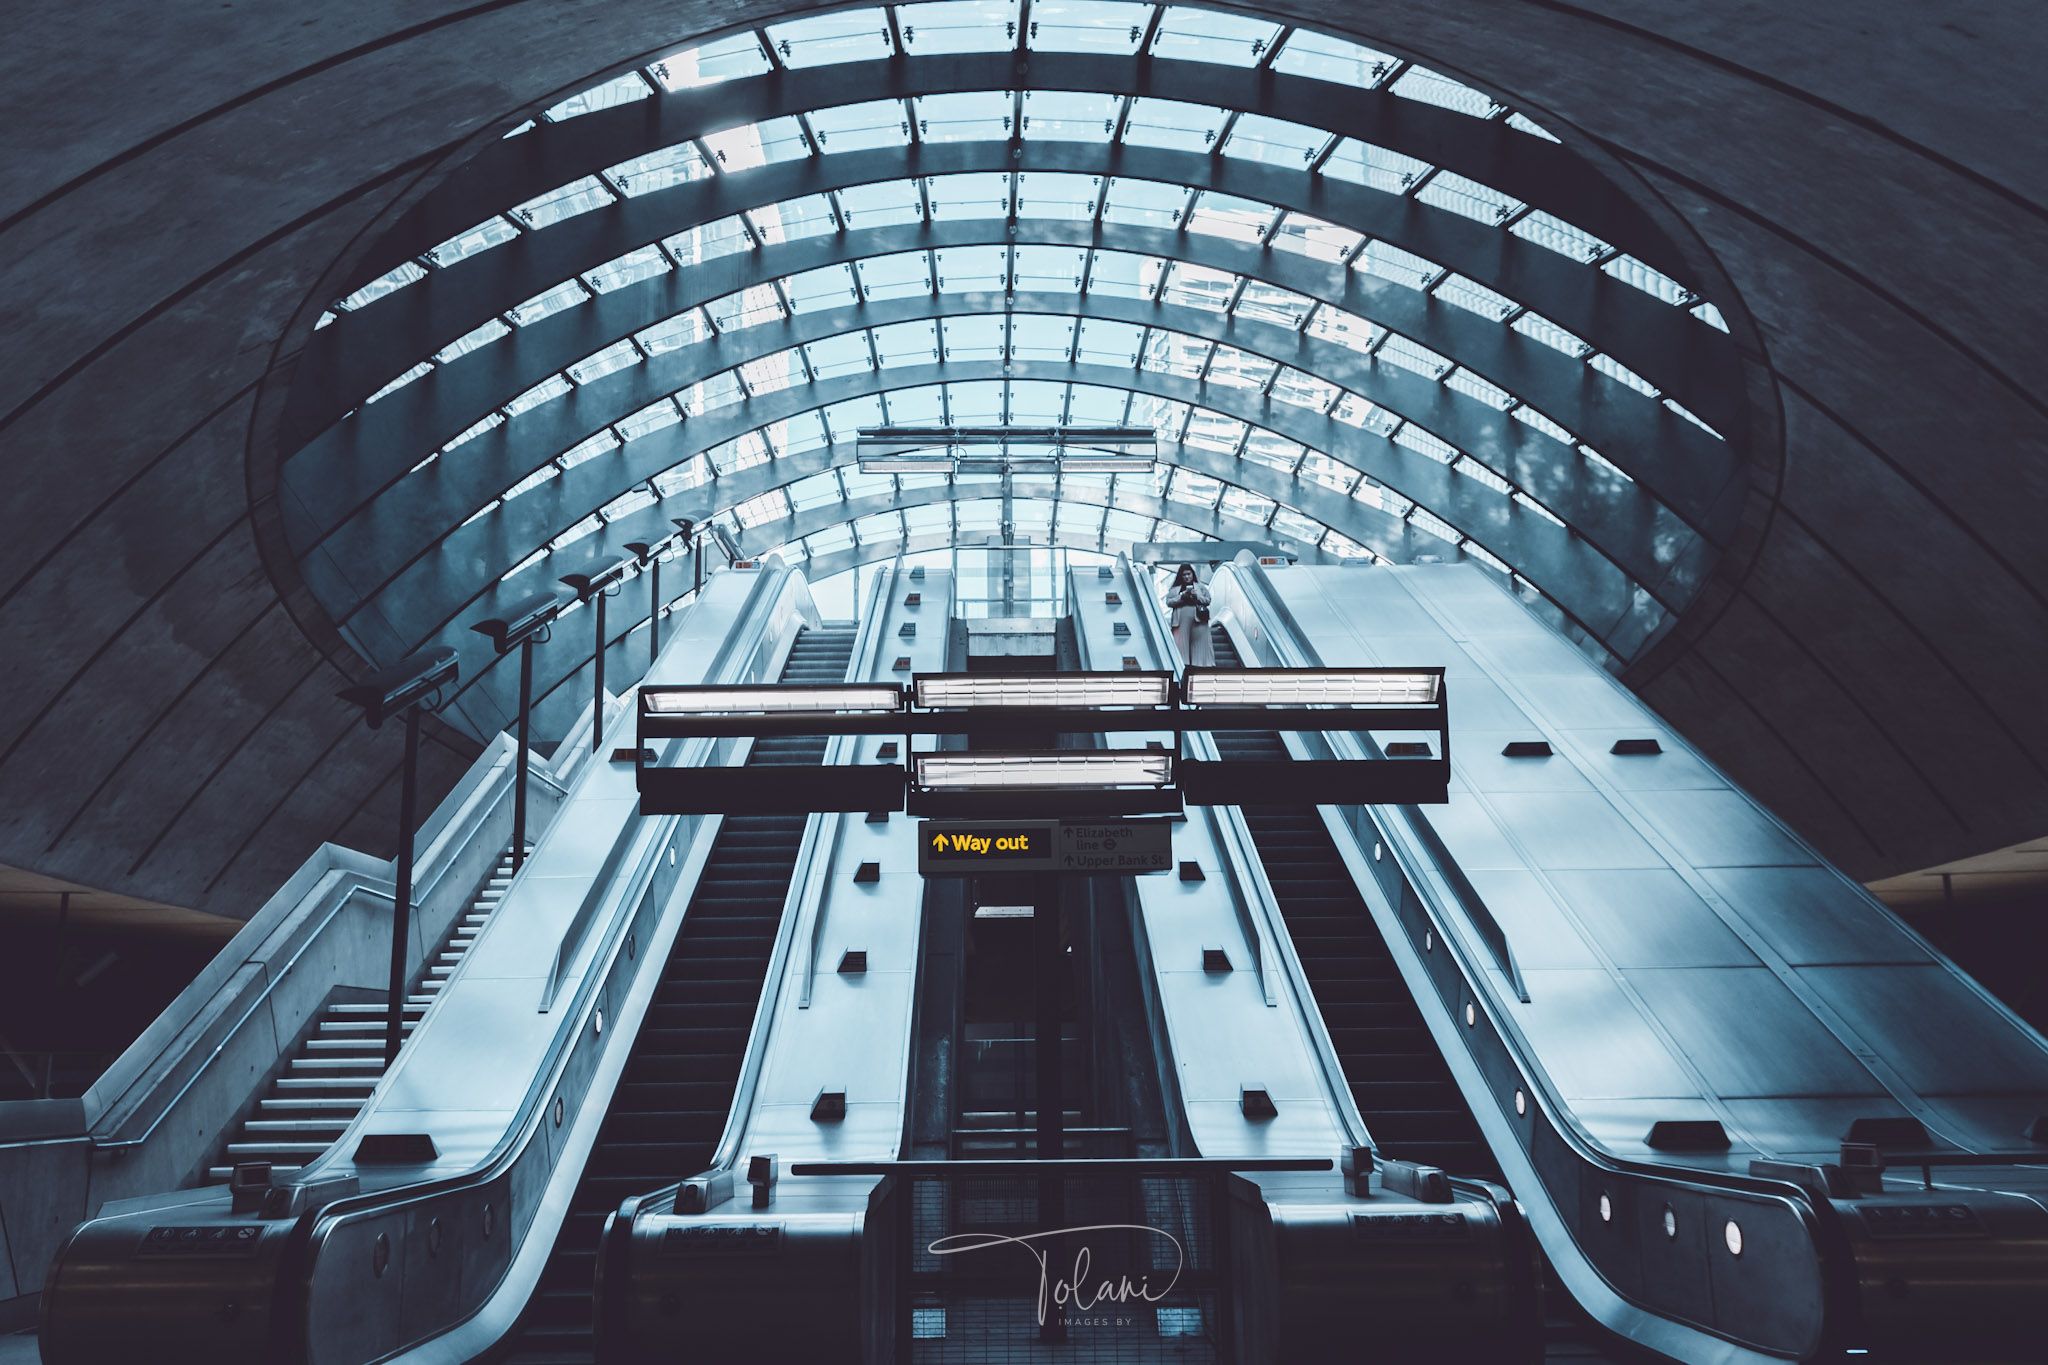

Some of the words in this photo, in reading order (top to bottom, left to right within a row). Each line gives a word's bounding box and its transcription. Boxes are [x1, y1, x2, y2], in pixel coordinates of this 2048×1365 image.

[1076, 827, 1133, 838] Elizabeth
[951, 834, 991, 855] Way
[996, 834, 1028, 850] out
[1076, 840, 1099, 850] line
[1077, 855, 1114, 867] Upper
[1118, 855, 1149, 865] Bank
[1151, 855, 1165, 865] St
